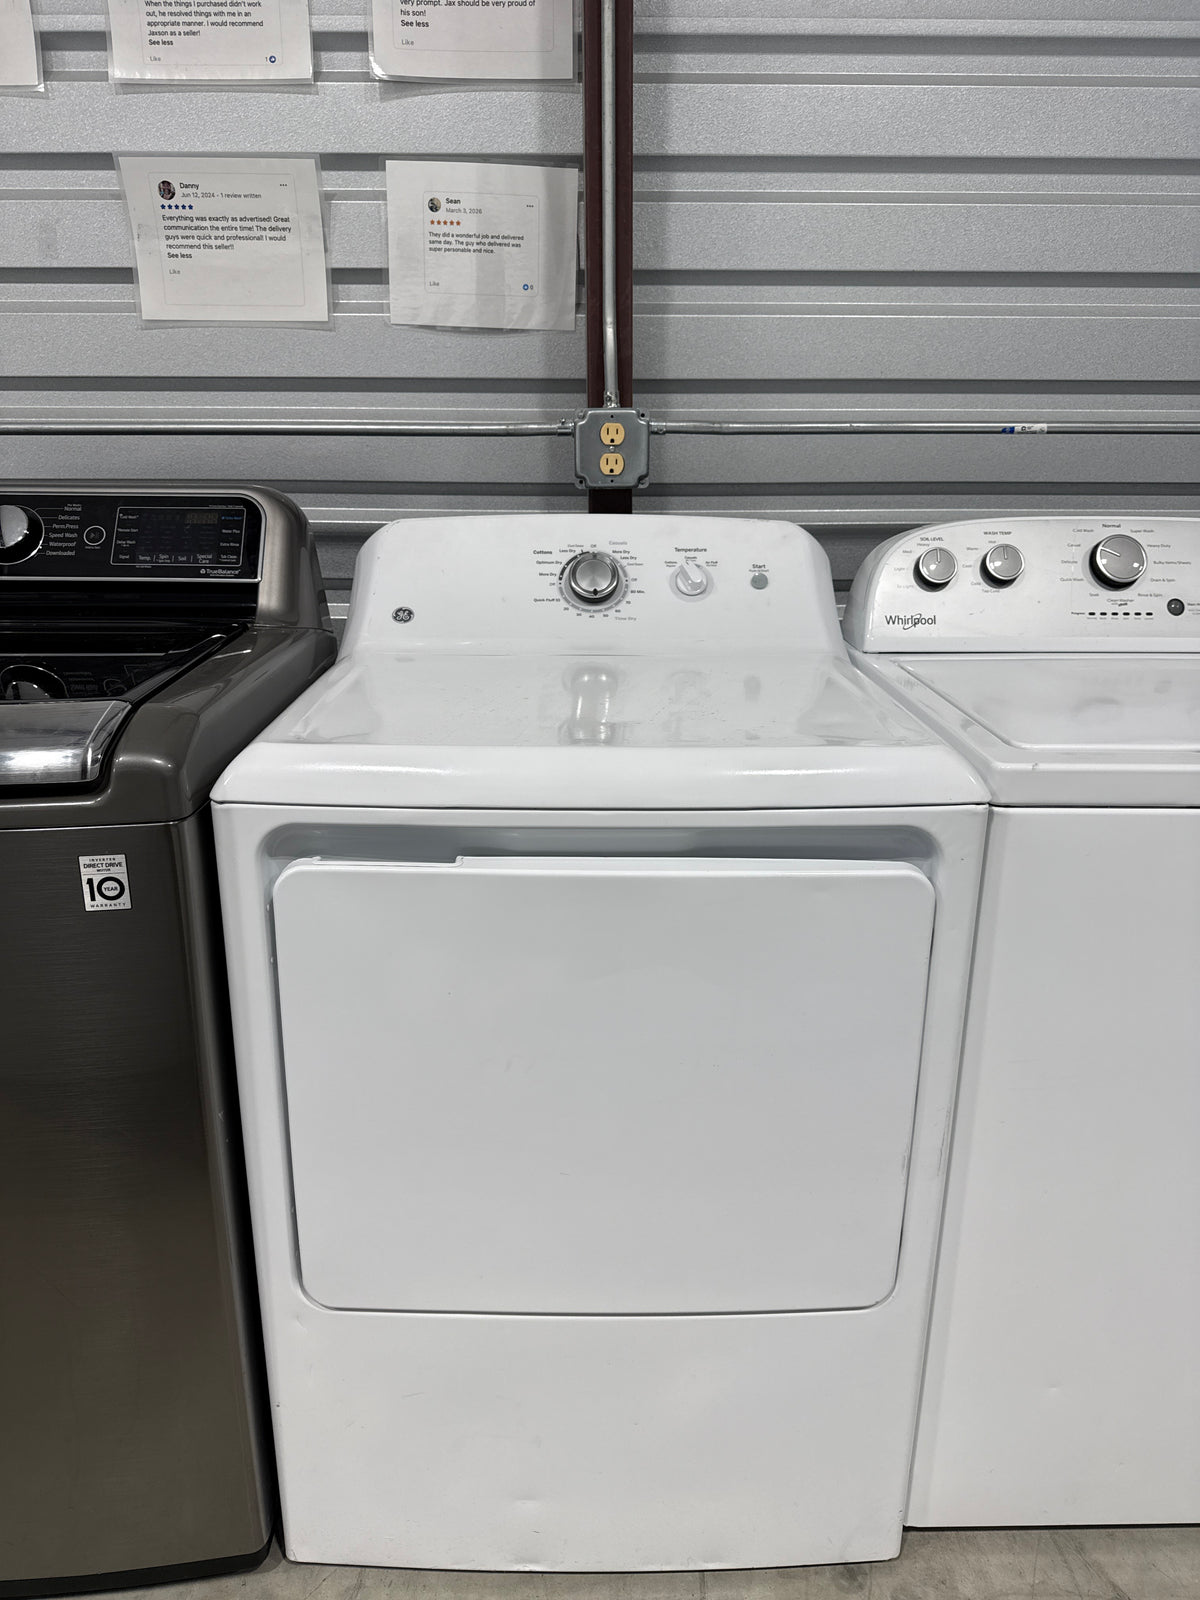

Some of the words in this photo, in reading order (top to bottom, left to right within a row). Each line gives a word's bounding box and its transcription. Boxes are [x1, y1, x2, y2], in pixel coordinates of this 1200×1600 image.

[491, 0, 506, 8] very
[507, 0, 527, 8] proud
[400, 19, 414, 27] See
[415, 20, 430, 28] less
[148, 38, 161, 46] See
[161, 38, 174, 46] less
[179, 182, 200, 190] Danny
[445, 197, 461, 205] Sean
[162, 214, 194, 223] Everything
[208, 215, 229, 223] exactly
[268, 225, 291, 233] delivery
[885, 613, 936, 630] Whirlpool
[86, 876, 126, 902] 10
